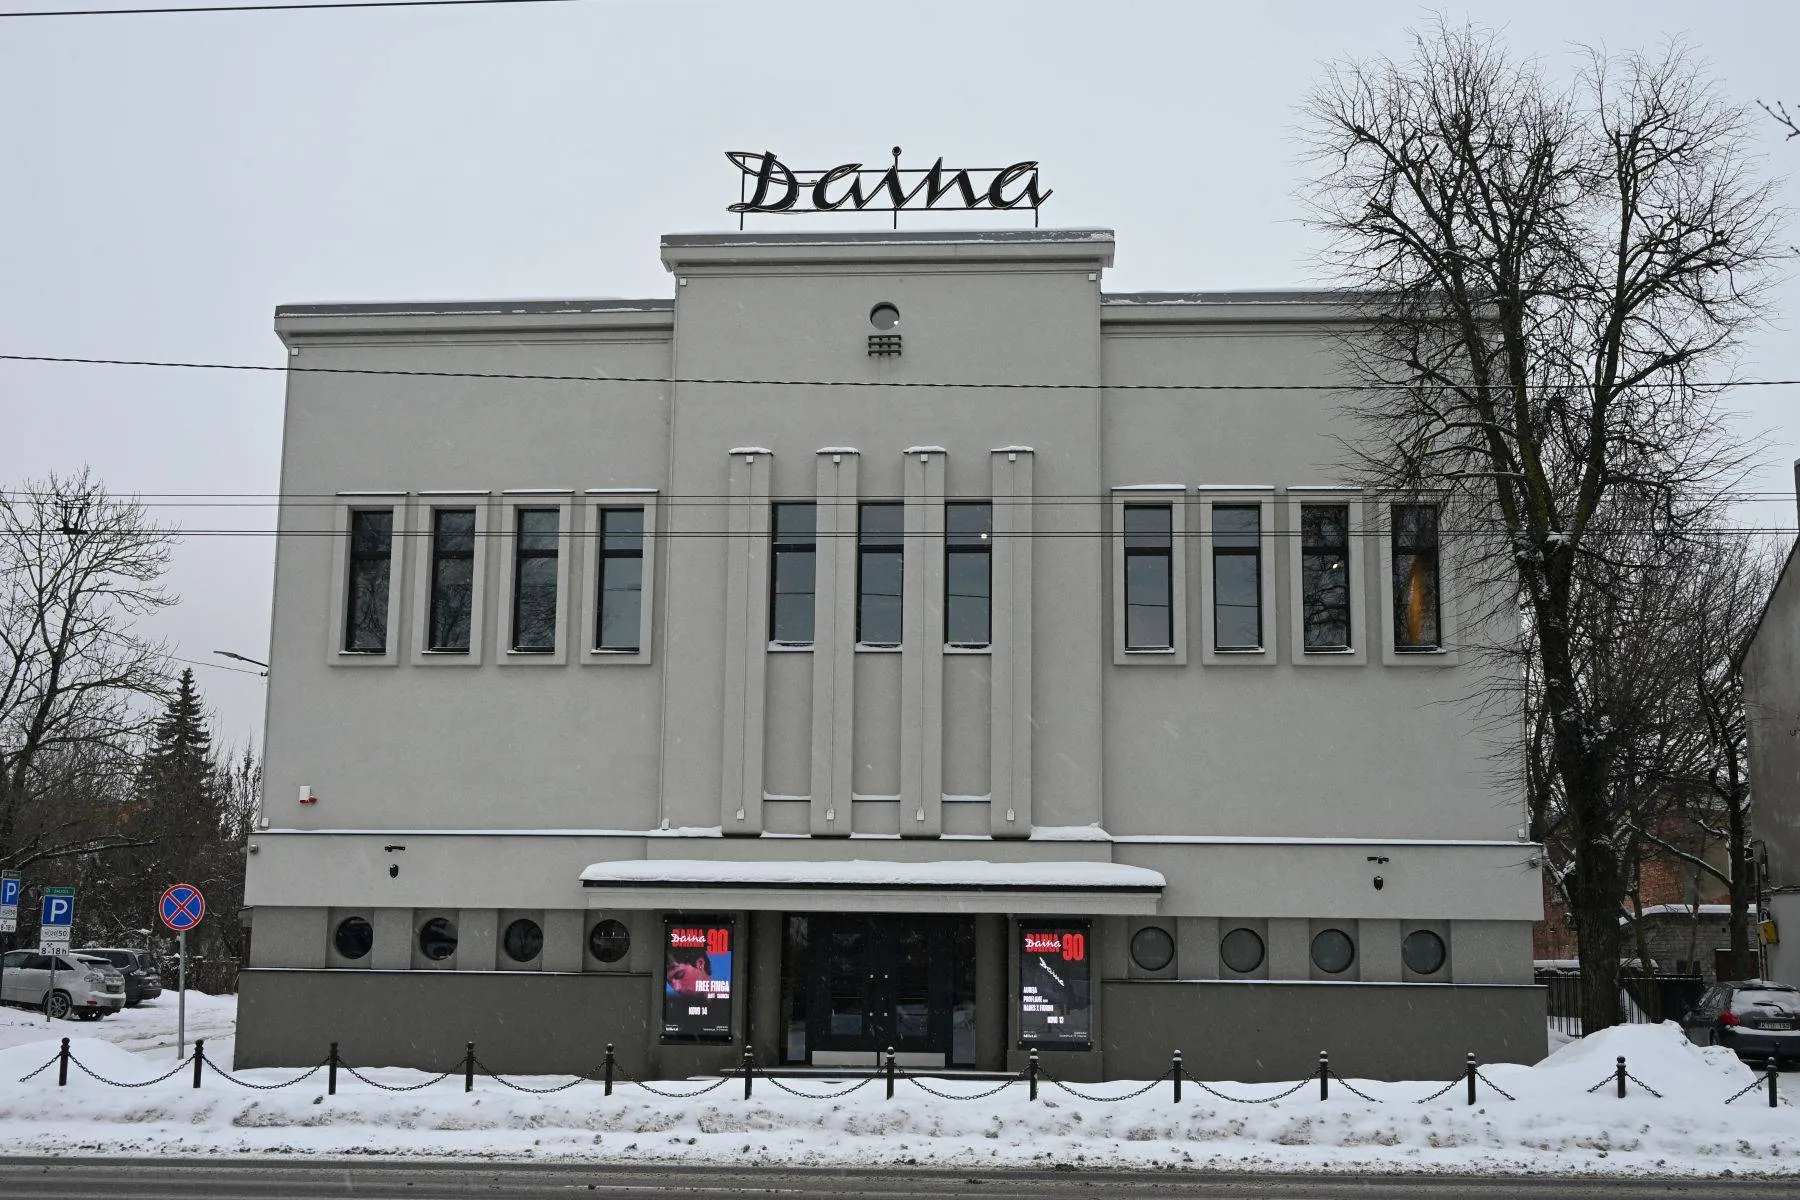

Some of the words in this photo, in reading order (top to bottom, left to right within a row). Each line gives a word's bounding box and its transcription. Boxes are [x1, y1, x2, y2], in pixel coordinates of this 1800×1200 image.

[725, 146, 1053, 214] Daina
[6, 883, 17, 903] P
[50, 899, 68, 922] P
[670, 933, 707, 943] Daina
[707, 928, 729, 955] 90
[1024, 938, 1062, 948] Daina
[1062, 933, 1084, 961] 90
[1039, 956, 1065, 987] Daina
[695, 980, 710, 992] FREE
